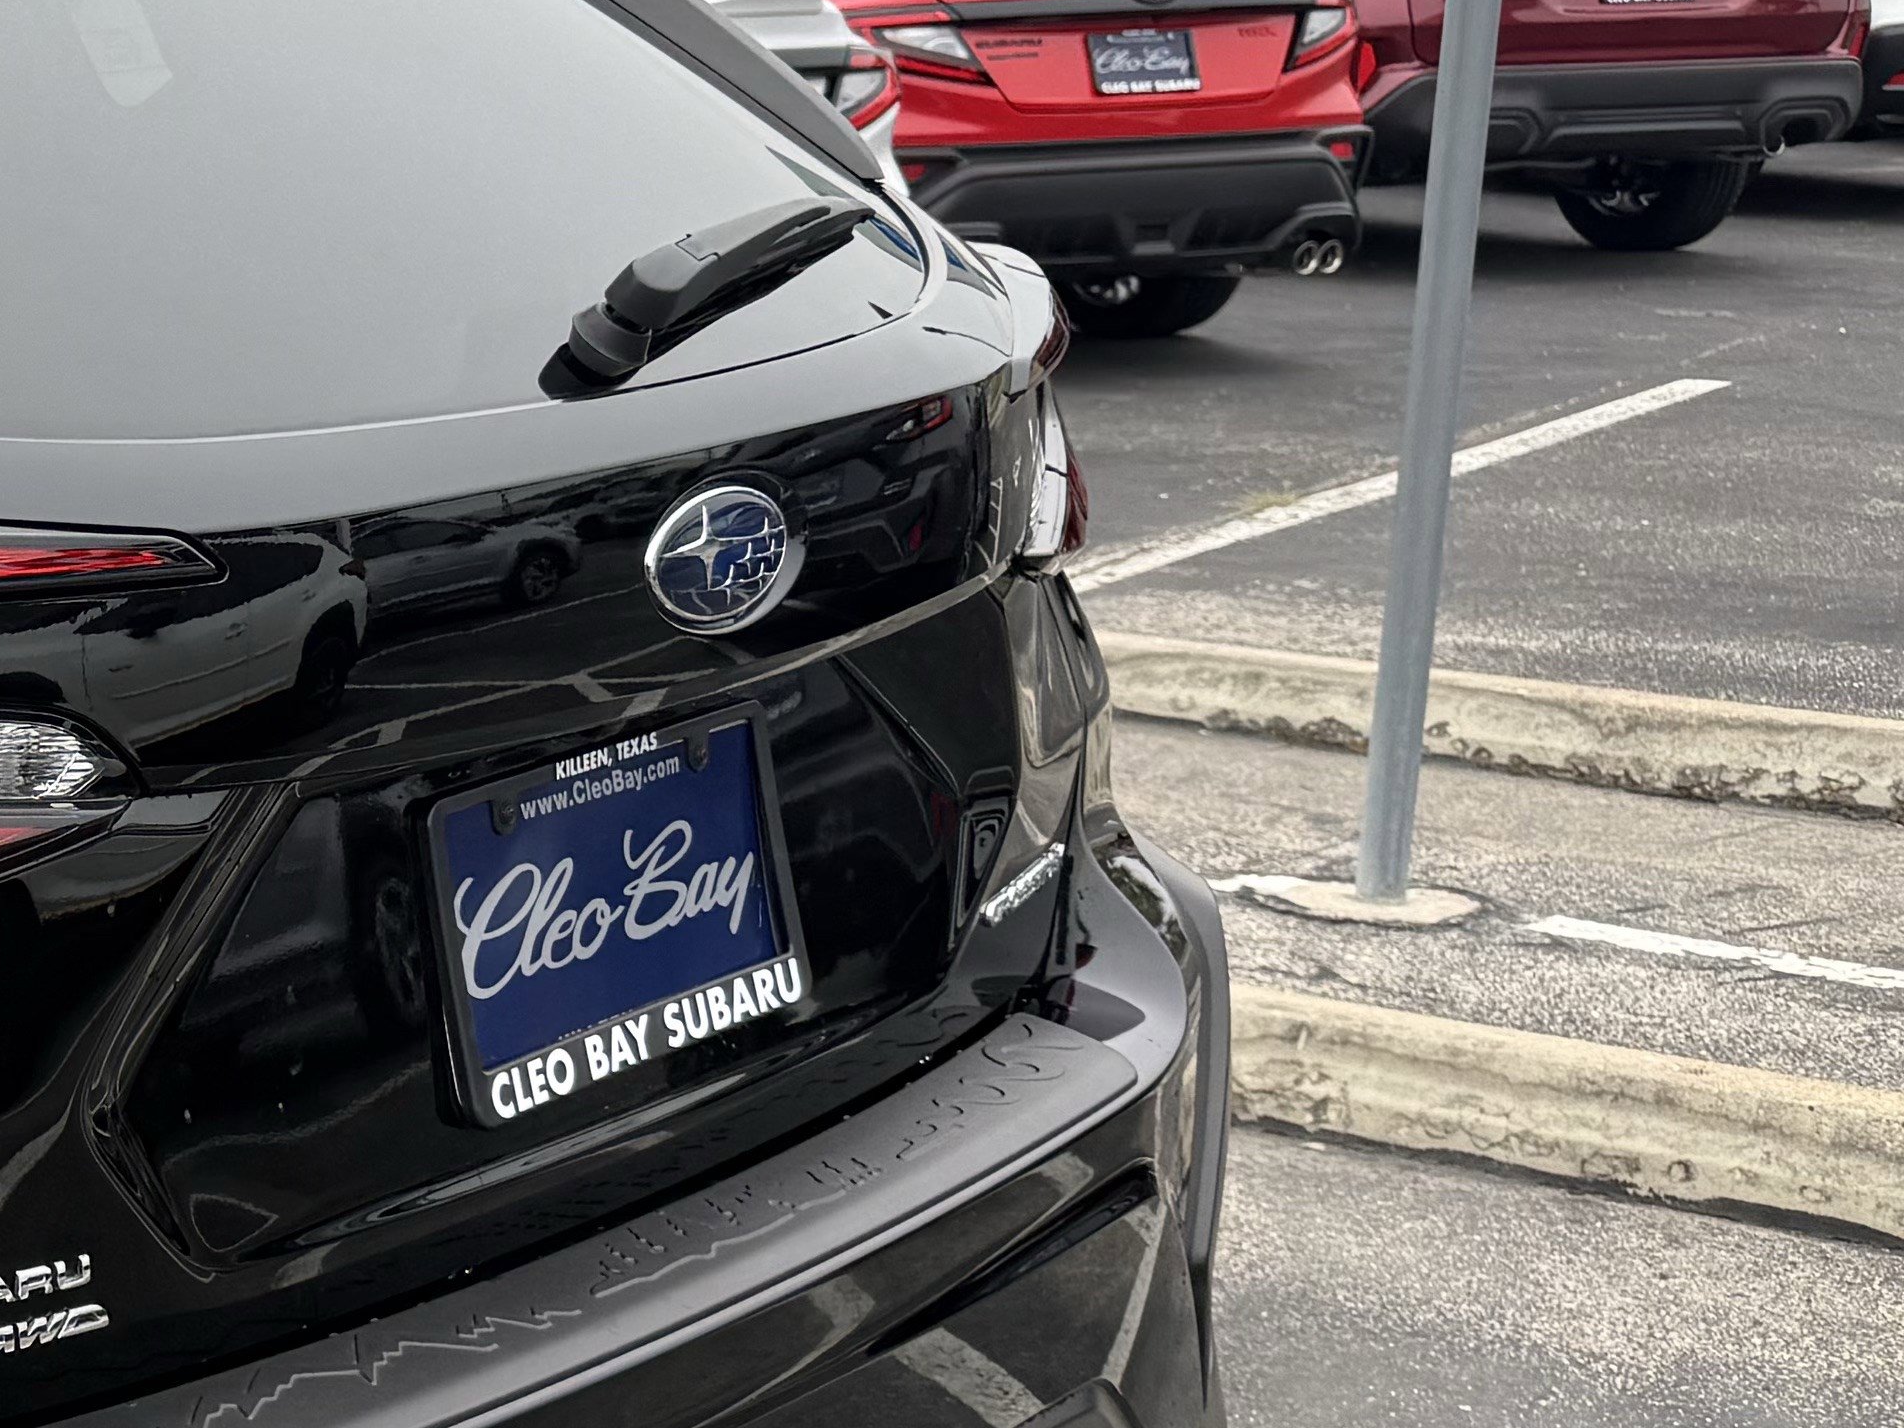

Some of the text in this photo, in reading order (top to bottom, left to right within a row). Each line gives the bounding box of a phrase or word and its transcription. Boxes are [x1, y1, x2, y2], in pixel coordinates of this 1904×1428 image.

[520, 756, 680, 820] www.CleoBay.com
[555, 732, 658, 780] KILLEEN, TEXAS
[454, 819, 754, 999] Cleo Bay
[491, 1047, 575, 1119] CLEO
[584, 1013, 649, 1081] BAY
[663, 958, 803, 1049] SUBARU
